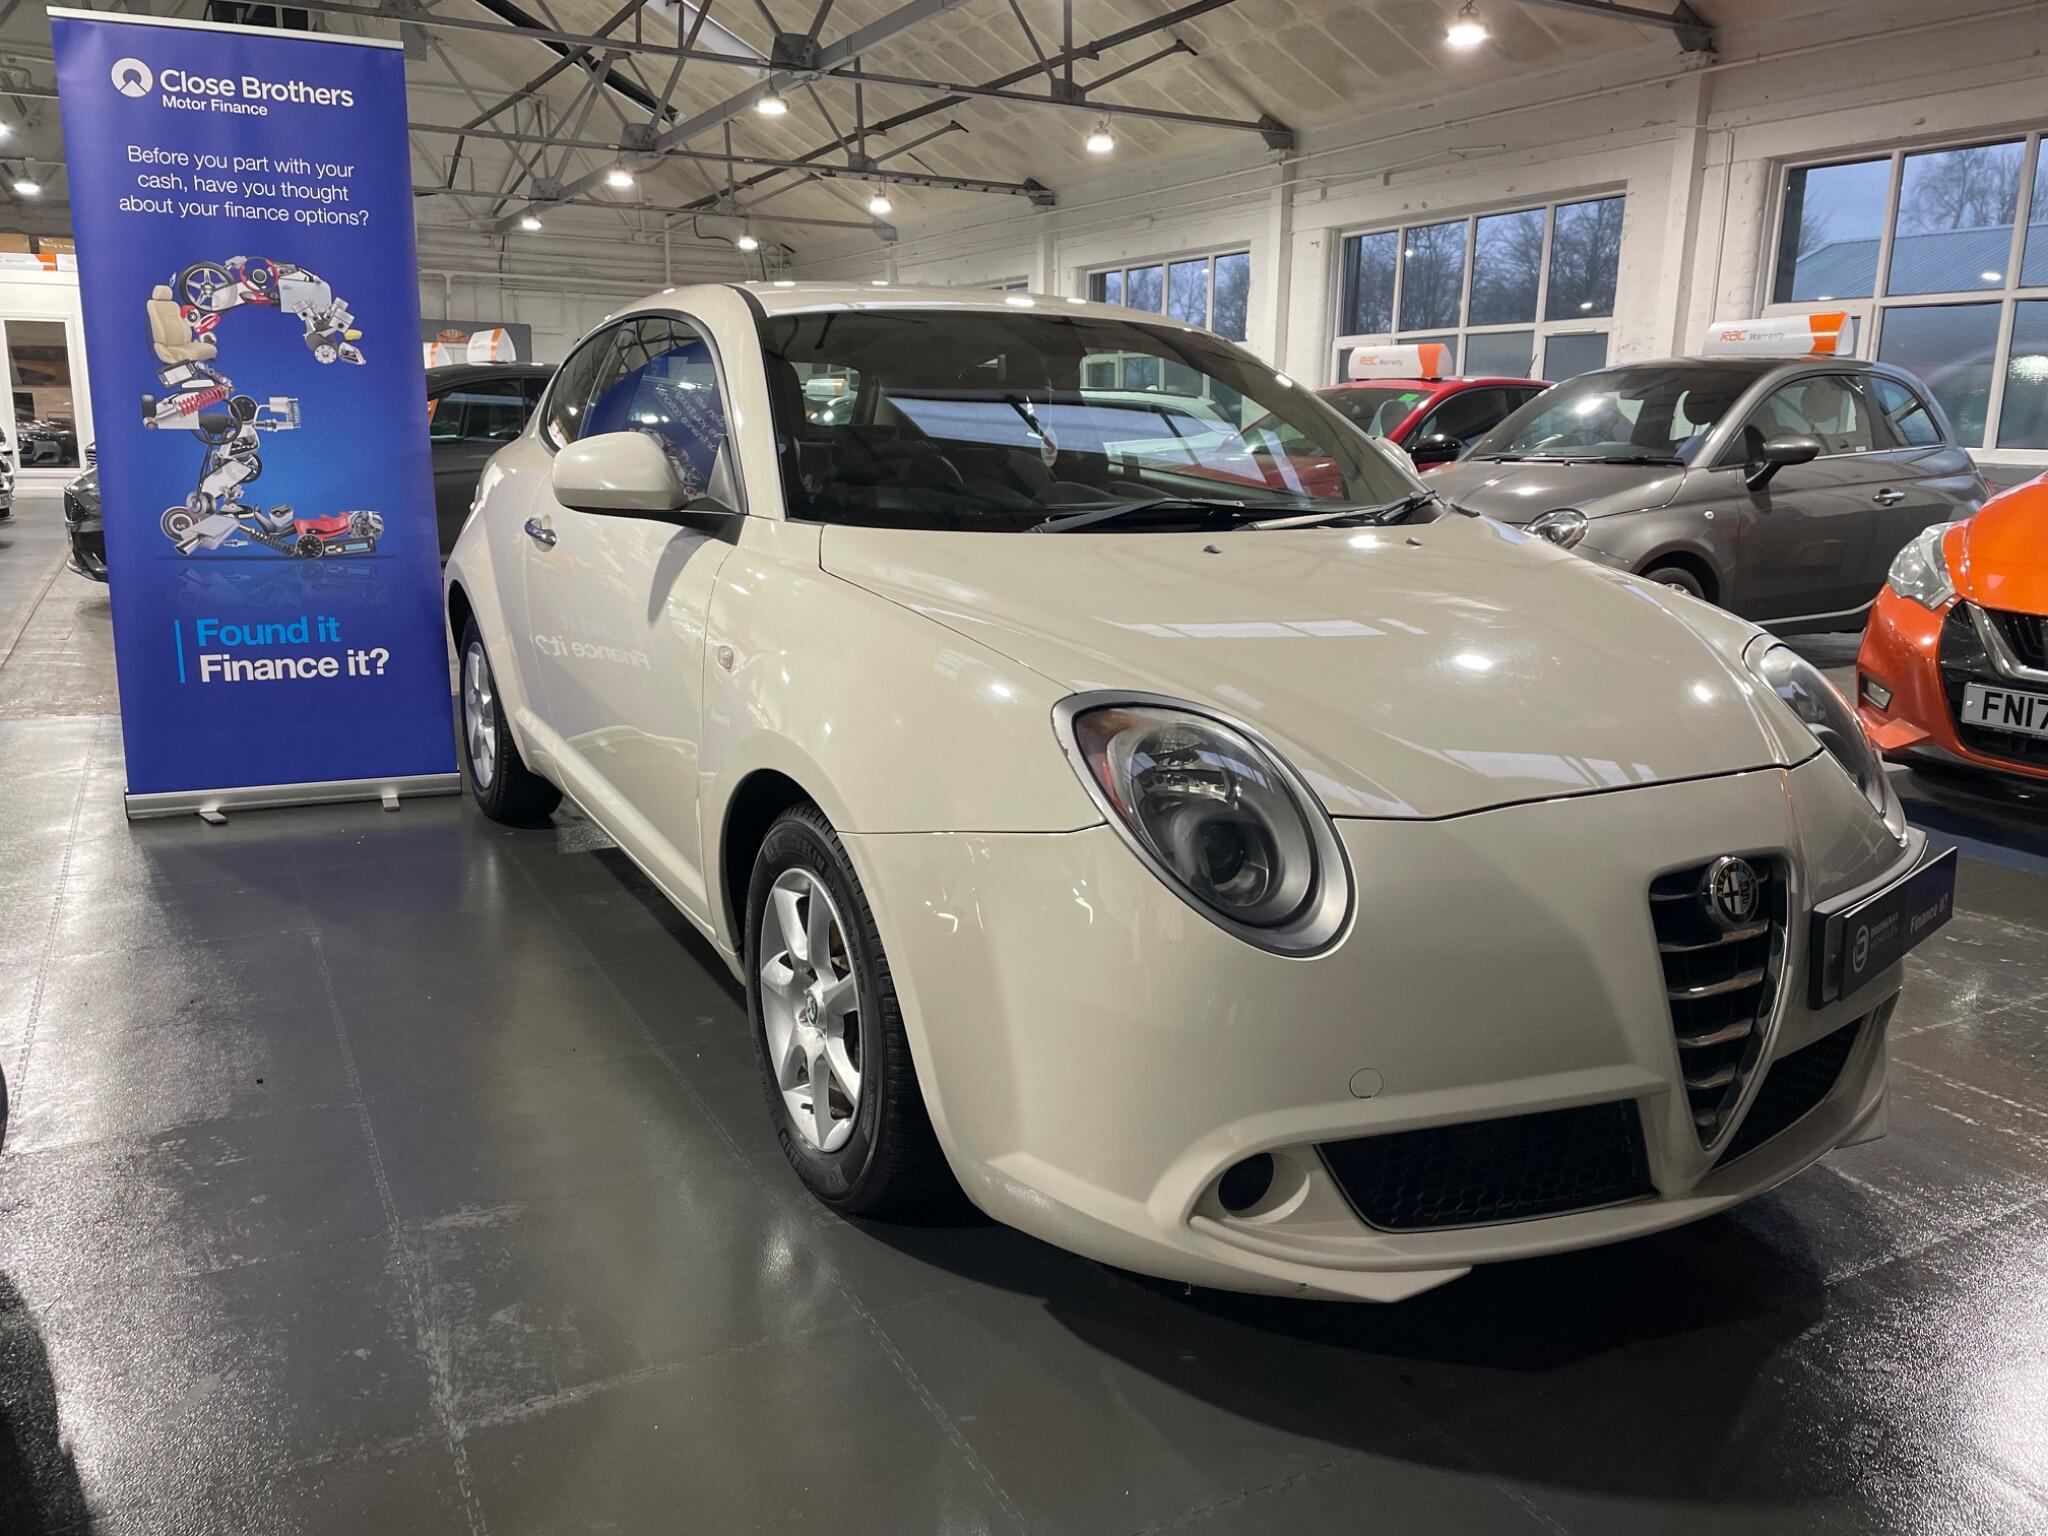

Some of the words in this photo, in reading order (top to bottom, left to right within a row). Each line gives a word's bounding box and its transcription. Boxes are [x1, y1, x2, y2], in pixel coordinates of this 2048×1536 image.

[160, 69, 236, 96] Close
[241, 75, 354, 107] Brothers
[162, 95, 207, 111] Motor
[211, 99, 268, 116] Finance
[127, 145, 189, 166] Before
[194, 153, 227, 171] you
[234, 155, 269, 173] part
[274, 158, 311, 175] with
[316, 162, 354, 180] your
[138, 173, 188, 192] cash,
[194, 175, 238, 194] have
[243, 182, 275, 198] you
[280, 183, 350, 204] thought
[119, 195, 174, 214] about
[179, 202, 219, 218] your
[224, 201, 289, 221] finance
[295, 209, 369, 227] options?
[1720, 329, 1748, 342] RAC
[1750, 331, 1786, 342] Warranty
[196, 616, 309, 647] Found
[318, 615, 341, 643] it
[200, 653, 339, 683] Finance
[347, 647, 390, 677] it?
